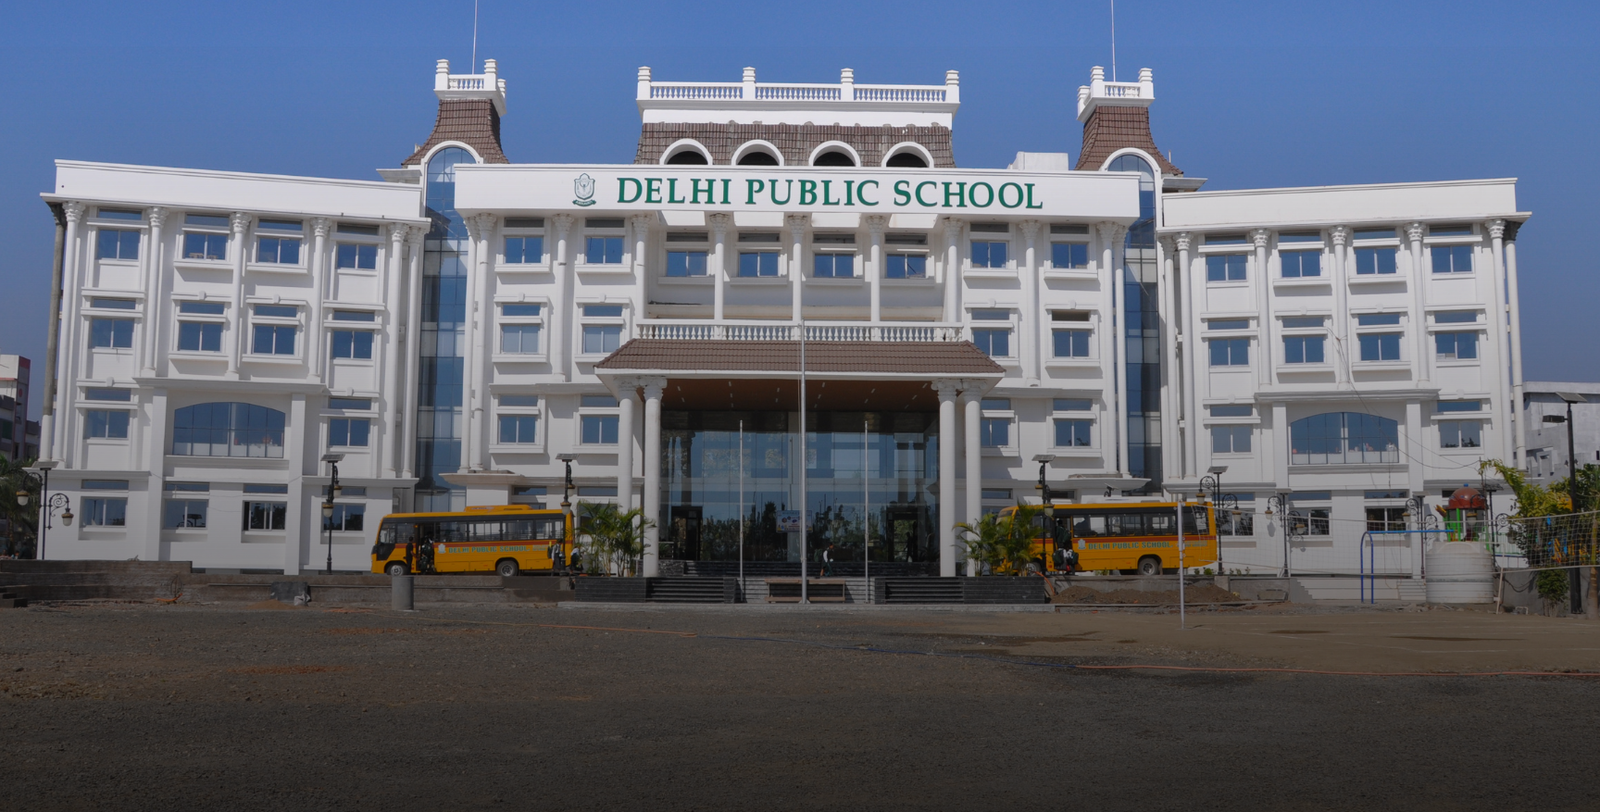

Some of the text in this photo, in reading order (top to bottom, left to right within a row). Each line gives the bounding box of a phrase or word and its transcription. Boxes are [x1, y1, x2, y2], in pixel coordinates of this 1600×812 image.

[616, 177, 1044, 209] DELHI PUBLIC SCHOOL
